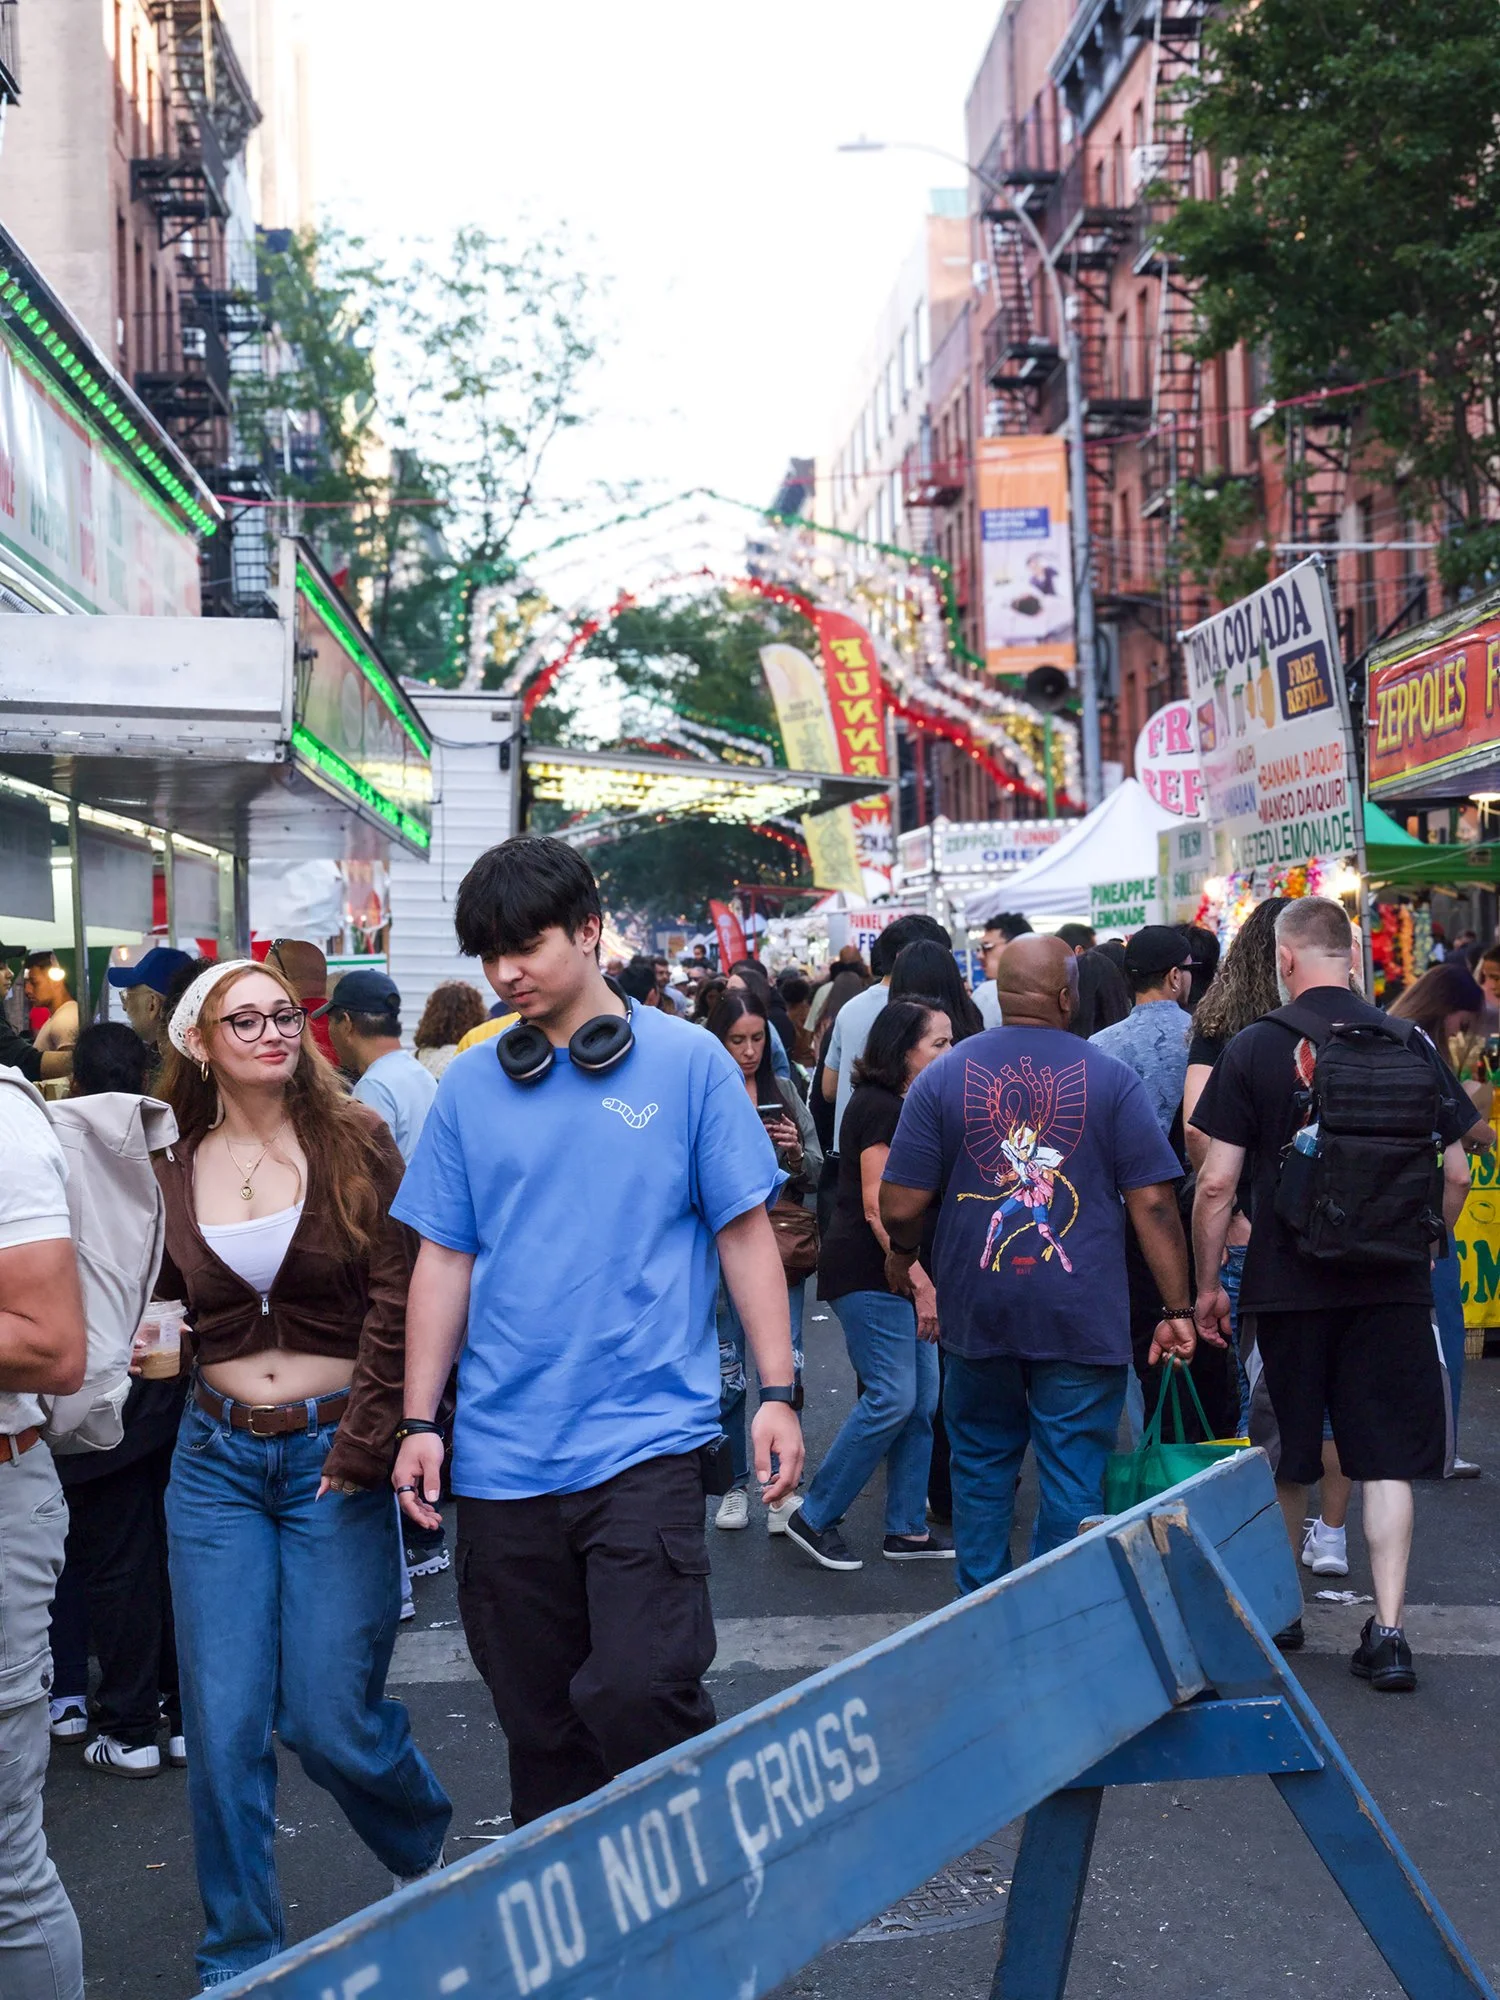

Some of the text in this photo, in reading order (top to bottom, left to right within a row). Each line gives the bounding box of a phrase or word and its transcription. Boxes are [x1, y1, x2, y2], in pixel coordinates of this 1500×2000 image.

[1223, 578, 1312, 669] COLADA
[1286, 652, 1319, 686] FREE
[1286, 679, 1328, 715] REFILL
[1376, 653, 1466, 755] ZEPPOLES
[1260, 742, 1343, 791] BANANA DAIQUIRI
[1260, 778, 1346, 825] MANGO DAIQUIRI
[1274, 811, 1353, 862] LEMONADE
[1091, 877, 1156, 906] PINEAPPLE
[1091, 906, 1146, 929] LEMONADE
[1380, 1627, 1400, 1638] UA
[497, 1861, 587, 1996] DO
[598, 1788, 708, 1935] NOT
[726, 1697, 881, 1856] CROSS
